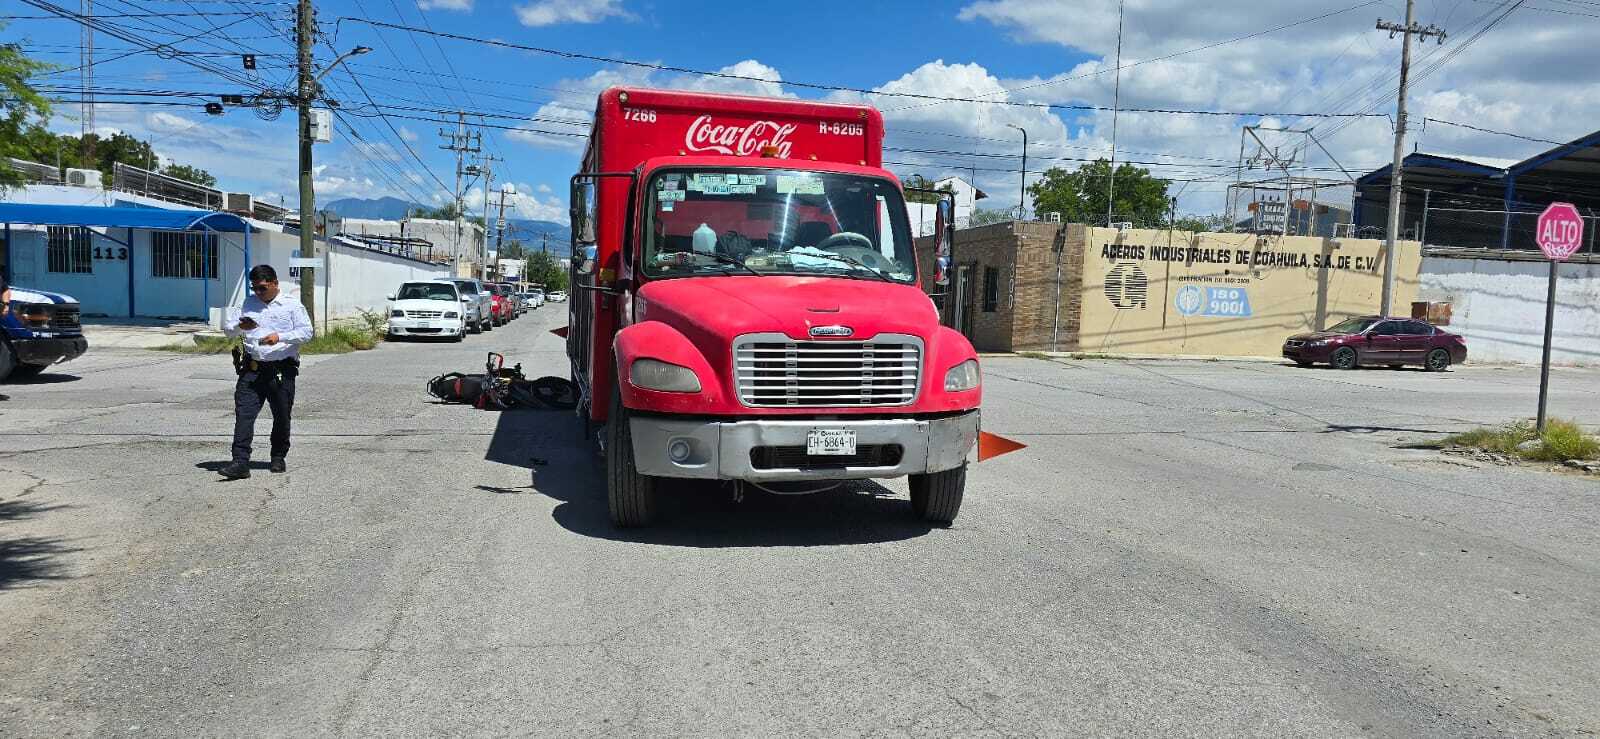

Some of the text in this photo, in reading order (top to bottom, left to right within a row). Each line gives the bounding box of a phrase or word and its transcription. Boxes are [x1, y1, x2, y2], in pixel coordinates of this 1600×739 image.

[623, 107, 657, 123] 7266
[686, 114, 798, 159] Coca-Cola
[1542, 219, 1577, 243] ALTO
[93, 246, 128, 261] 113
[1102, 243, 1145, 261] ACEROS
[1150, 245, 1231, 264] INDUSTRIALES
[1235, 250, 1250, 264] DE
[1338, 255, 1351, 269] DE
[1212, 289, 1240, 299] ISO
[1210, 300, 1245, 314] 9001
